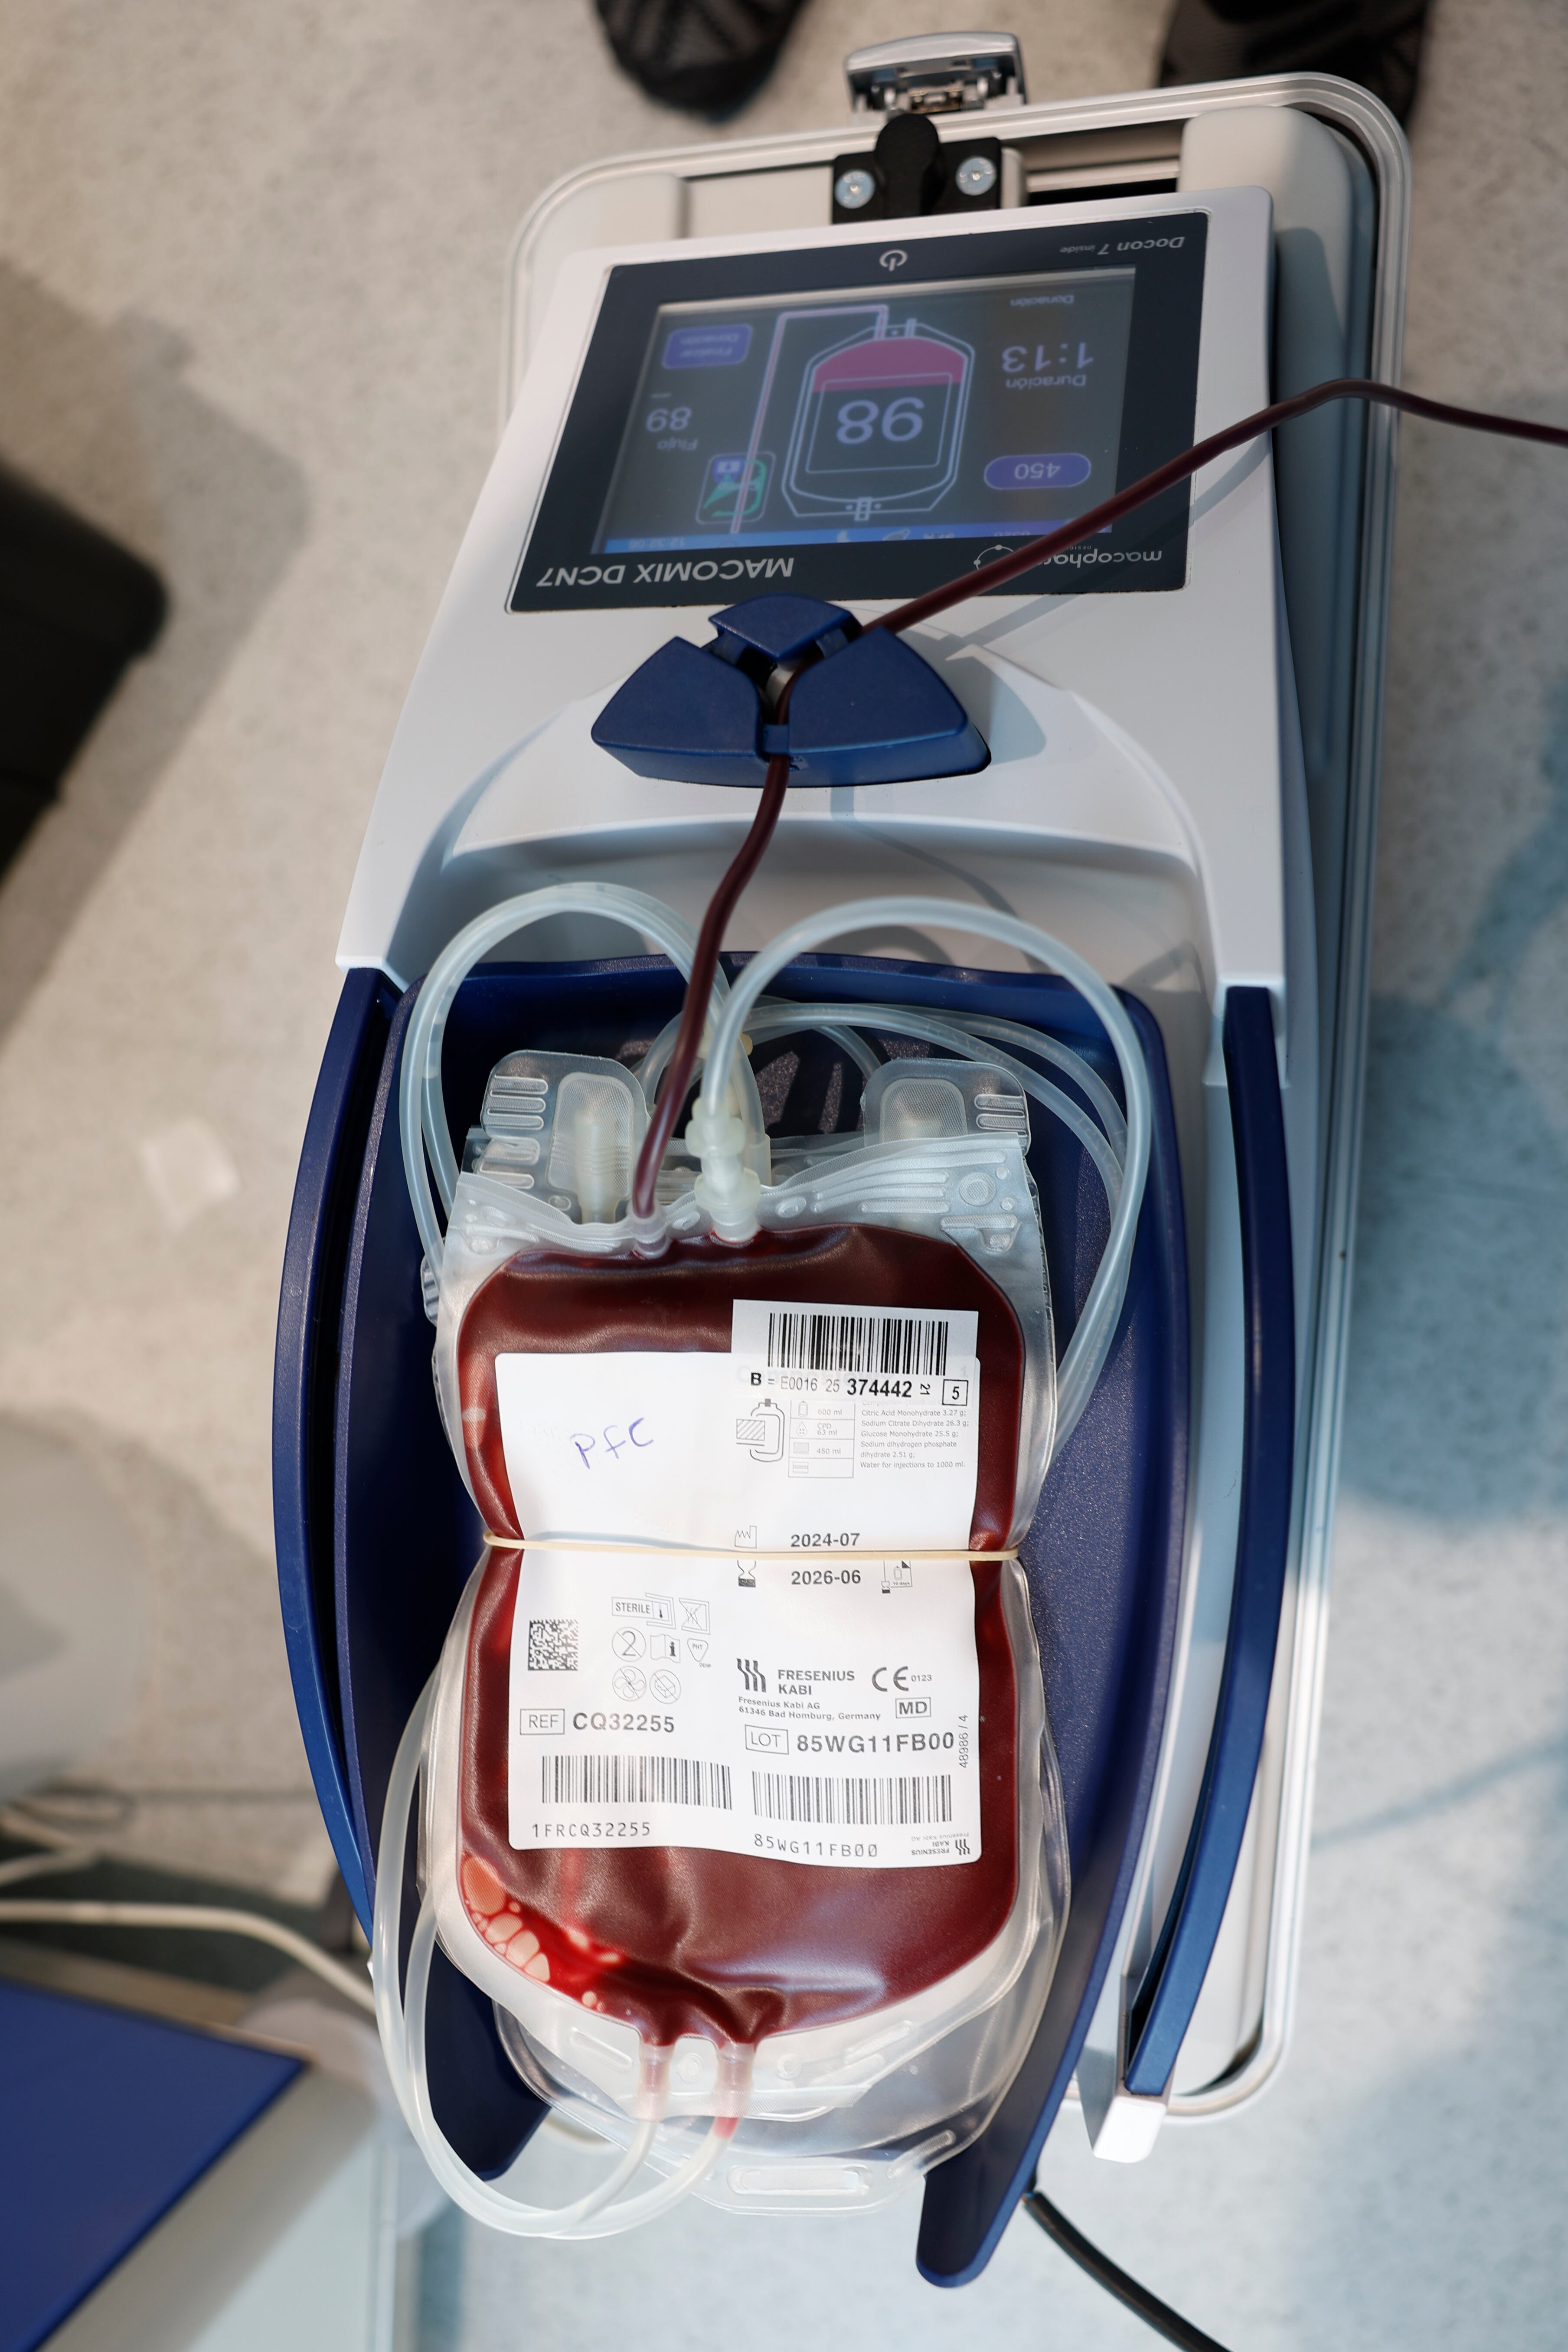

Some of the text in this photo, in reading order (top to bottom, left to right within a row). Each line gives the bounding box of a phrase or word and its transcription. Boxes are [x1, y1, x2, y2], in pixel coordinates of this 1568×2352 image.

[1060, 236, 1186, 255] Docon 7 inside
[1010, 294, 1074, 307] Donación
[1002, 342, 1093, 373] 1:13
[1006, 374, 1086, 390] Duración
[646, 406, 692, 432] 89
[836, 397, 925, 444] 98
[657, 438, 699, 451] Flujo
[1014, 463, 1061, 480] 450
[536, 557, 794, 587] MACOMIX DCN7
[751, 1372, 761, 1385] B
[781, 1375, 818, 1391] E0016
[826, 1379, 840, 1392] 25
[846, 1378, 912, 1398] 374442
[952, 1386, 960, 1400] 5
[791, 1533, 860, 1547] 2024-07
[791, 1570, 861, 1584] 2026-06
[615, 1601, 650, 1614] STERILE
[778, 1669, 855, 1681] FRESENIUS
[778, 1683, 812, 1695] KABI
[738, 1696, 781, 1708] Fresenius
[784, 1701, 804, 1709] Kabi
[899, 1701, 927, 1715] MD
[529, 1714, 559, 1728] REF
[739, 1705, 766, 1716] 61346
[789, 1712, 835, 1721] Homburg,
[838, 1712, 881, 1721] Germany
[572, 1712, 675, 1733] CQ32255
[751, 1731, 781, 1748] LOT
[797, 1731, 954, 1753] 85WG11FB00
[958, 1732, 969, 1768] 48986
[532, 1822, 650, 1838] 1FRCQ32255
[754, 1833, 878, 1857] 85WG11FB00
